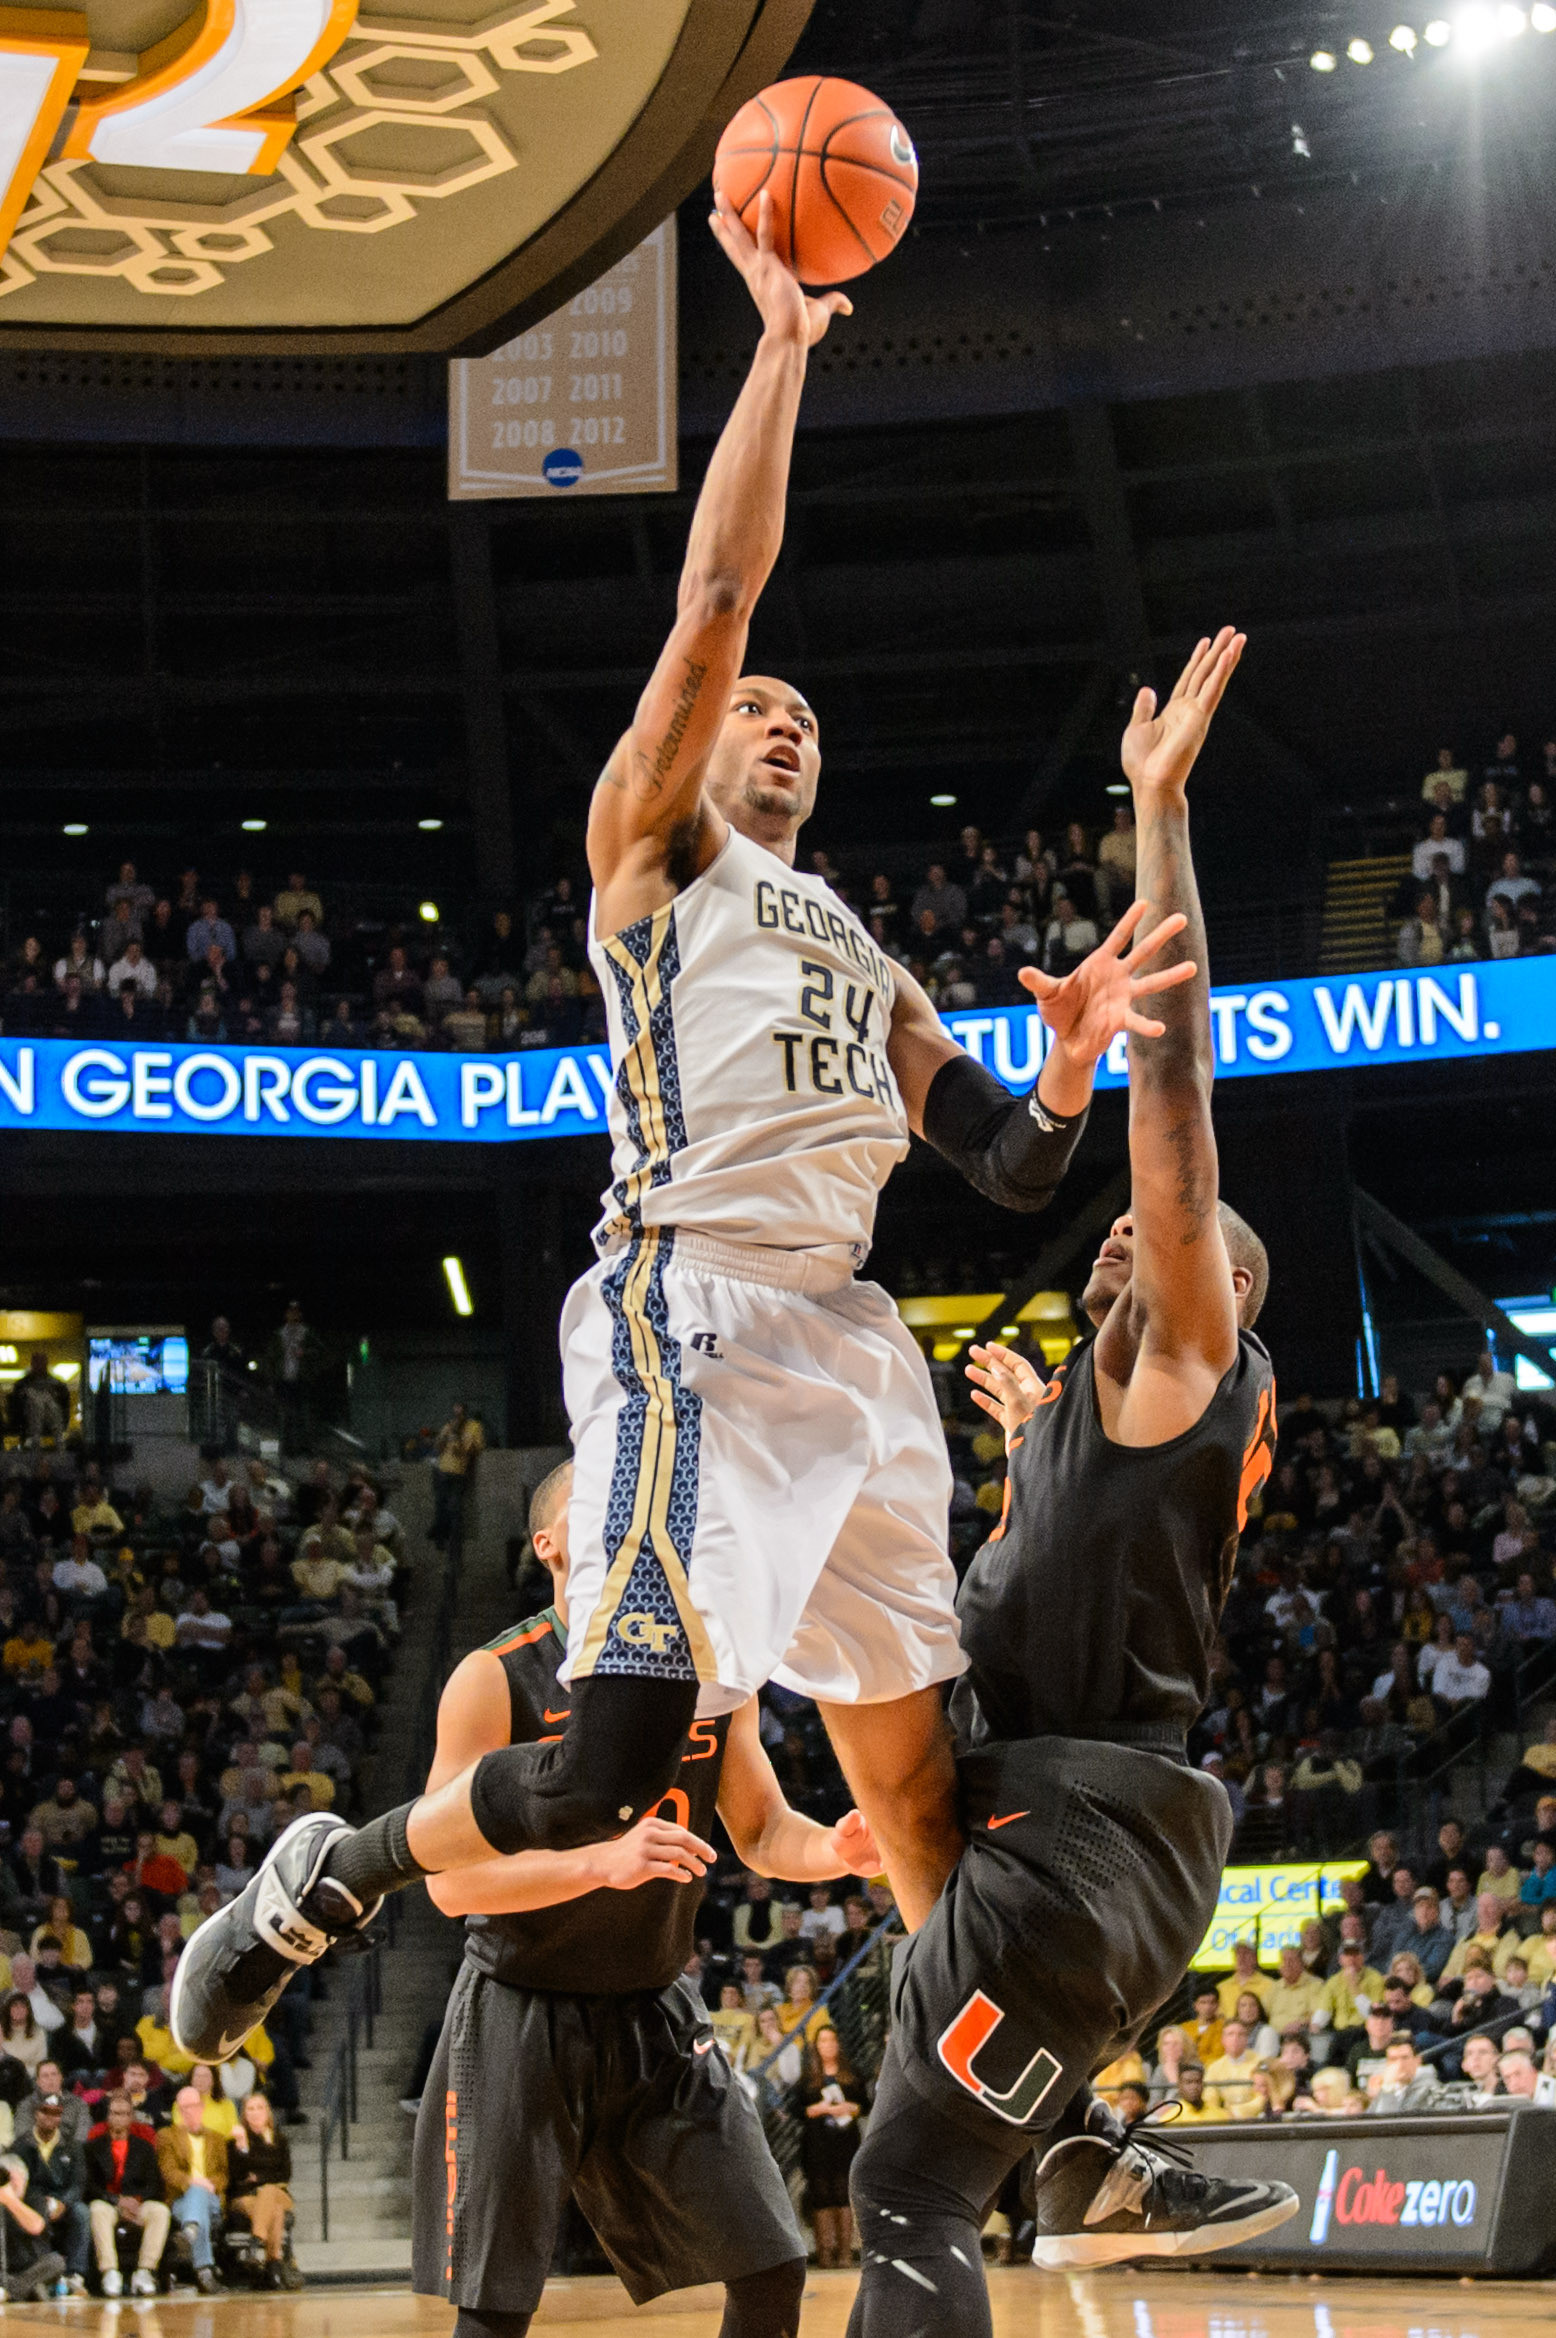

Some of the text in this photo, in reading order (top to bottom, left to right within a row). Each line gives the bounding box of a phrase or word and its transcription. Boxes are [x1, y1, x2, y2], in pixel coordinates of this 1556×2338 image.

[569, 287, 633, 317] 2009
[569, 329, 629, 359] 2010
[491, 373, 623, 406] 2007 2011
[491, 416, 626, 449] 2008 2012
[756, 880, 894, 1003] GEORGIA
[799, 956, 875, 1044] 24
[61, 1048, 438, 1128] GEORGIA
[1313, 972, 1501, 1055] WIN.
[772, 1032, 896, 1113] TECH
[617, 1611, 677, 1652] GT
[1269, 1875, 1343, 1903] Cente
